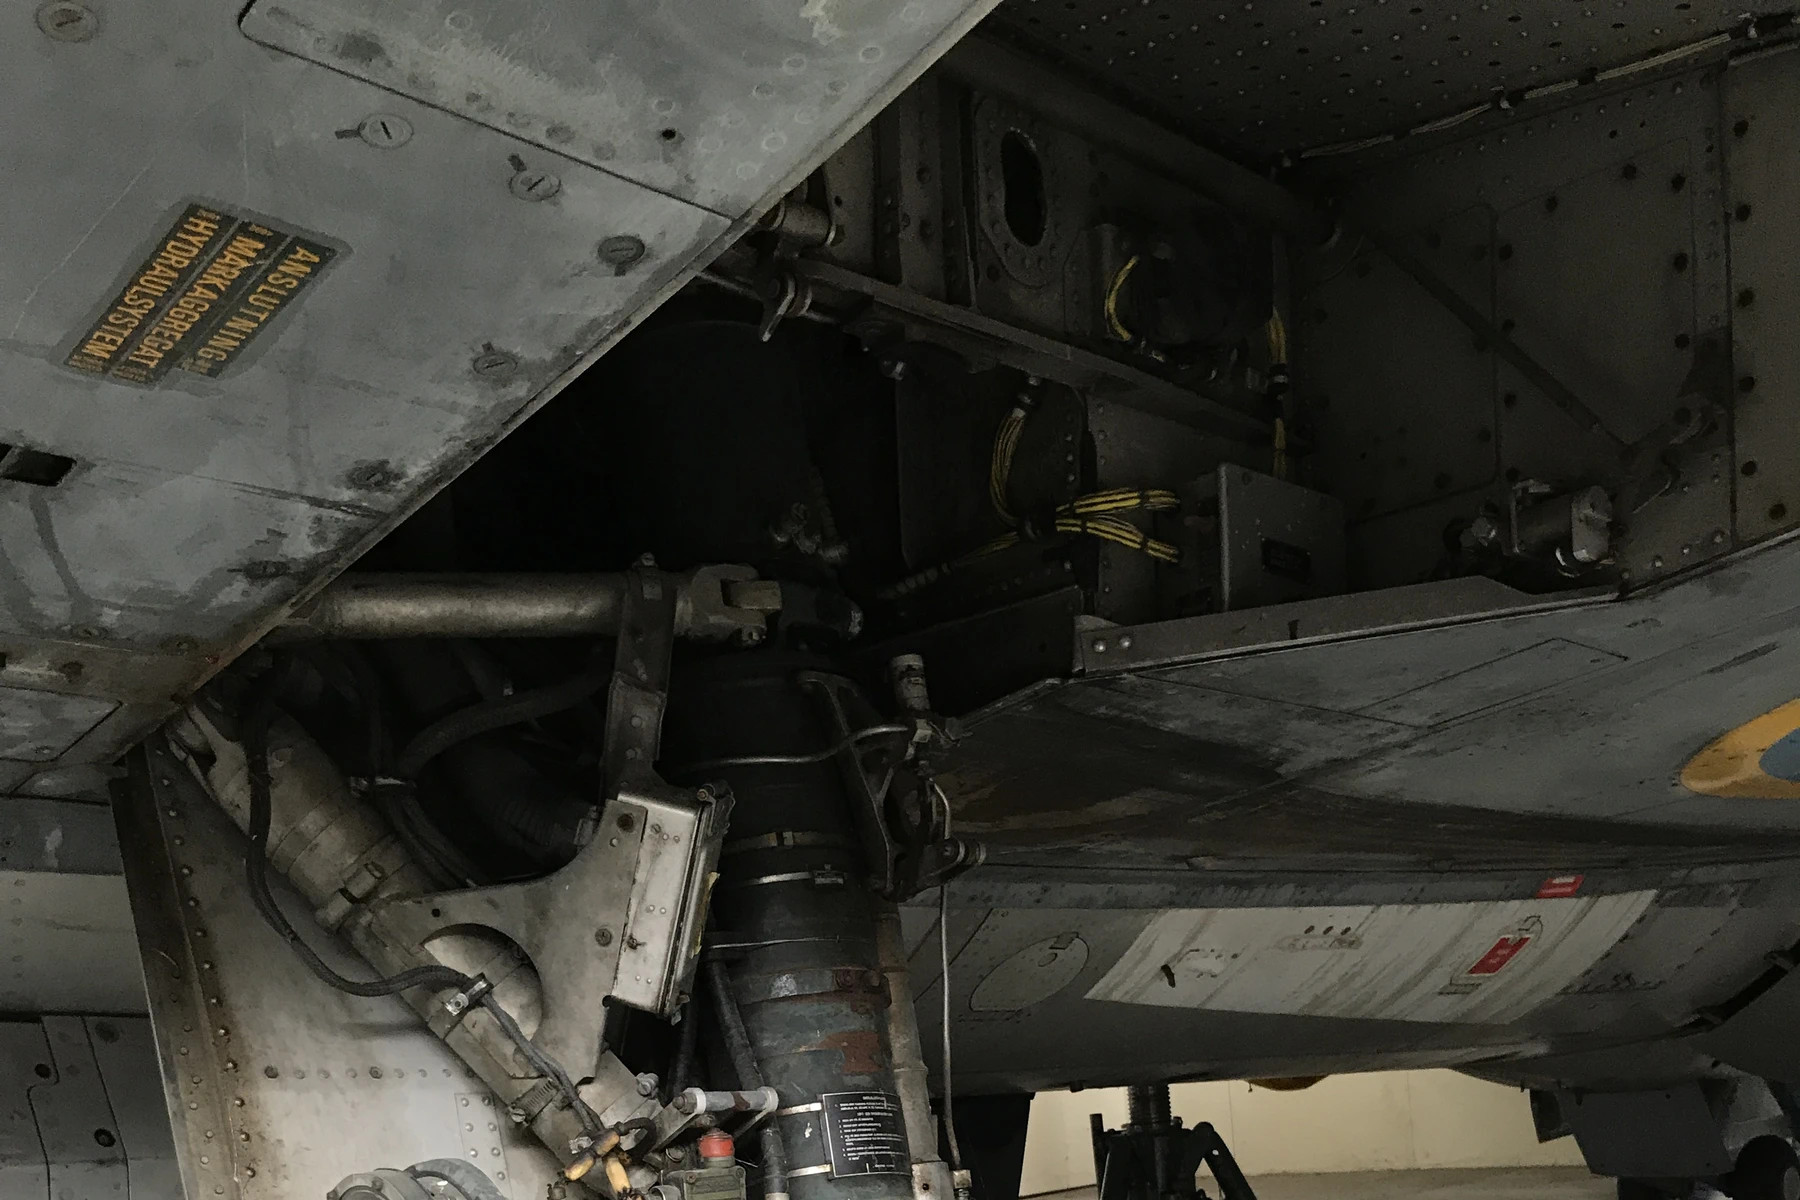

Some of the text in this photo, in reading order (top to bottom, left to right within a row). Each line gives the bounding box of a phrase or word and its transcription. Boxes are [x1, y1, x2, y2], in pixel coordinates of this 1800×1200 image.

[81, 217, 219, 360] HYDRAULSYSTEM
[128, 235, 265, 369] MARKAGGREGAT
[197, 245, 320, 361] ANSLUTNING
